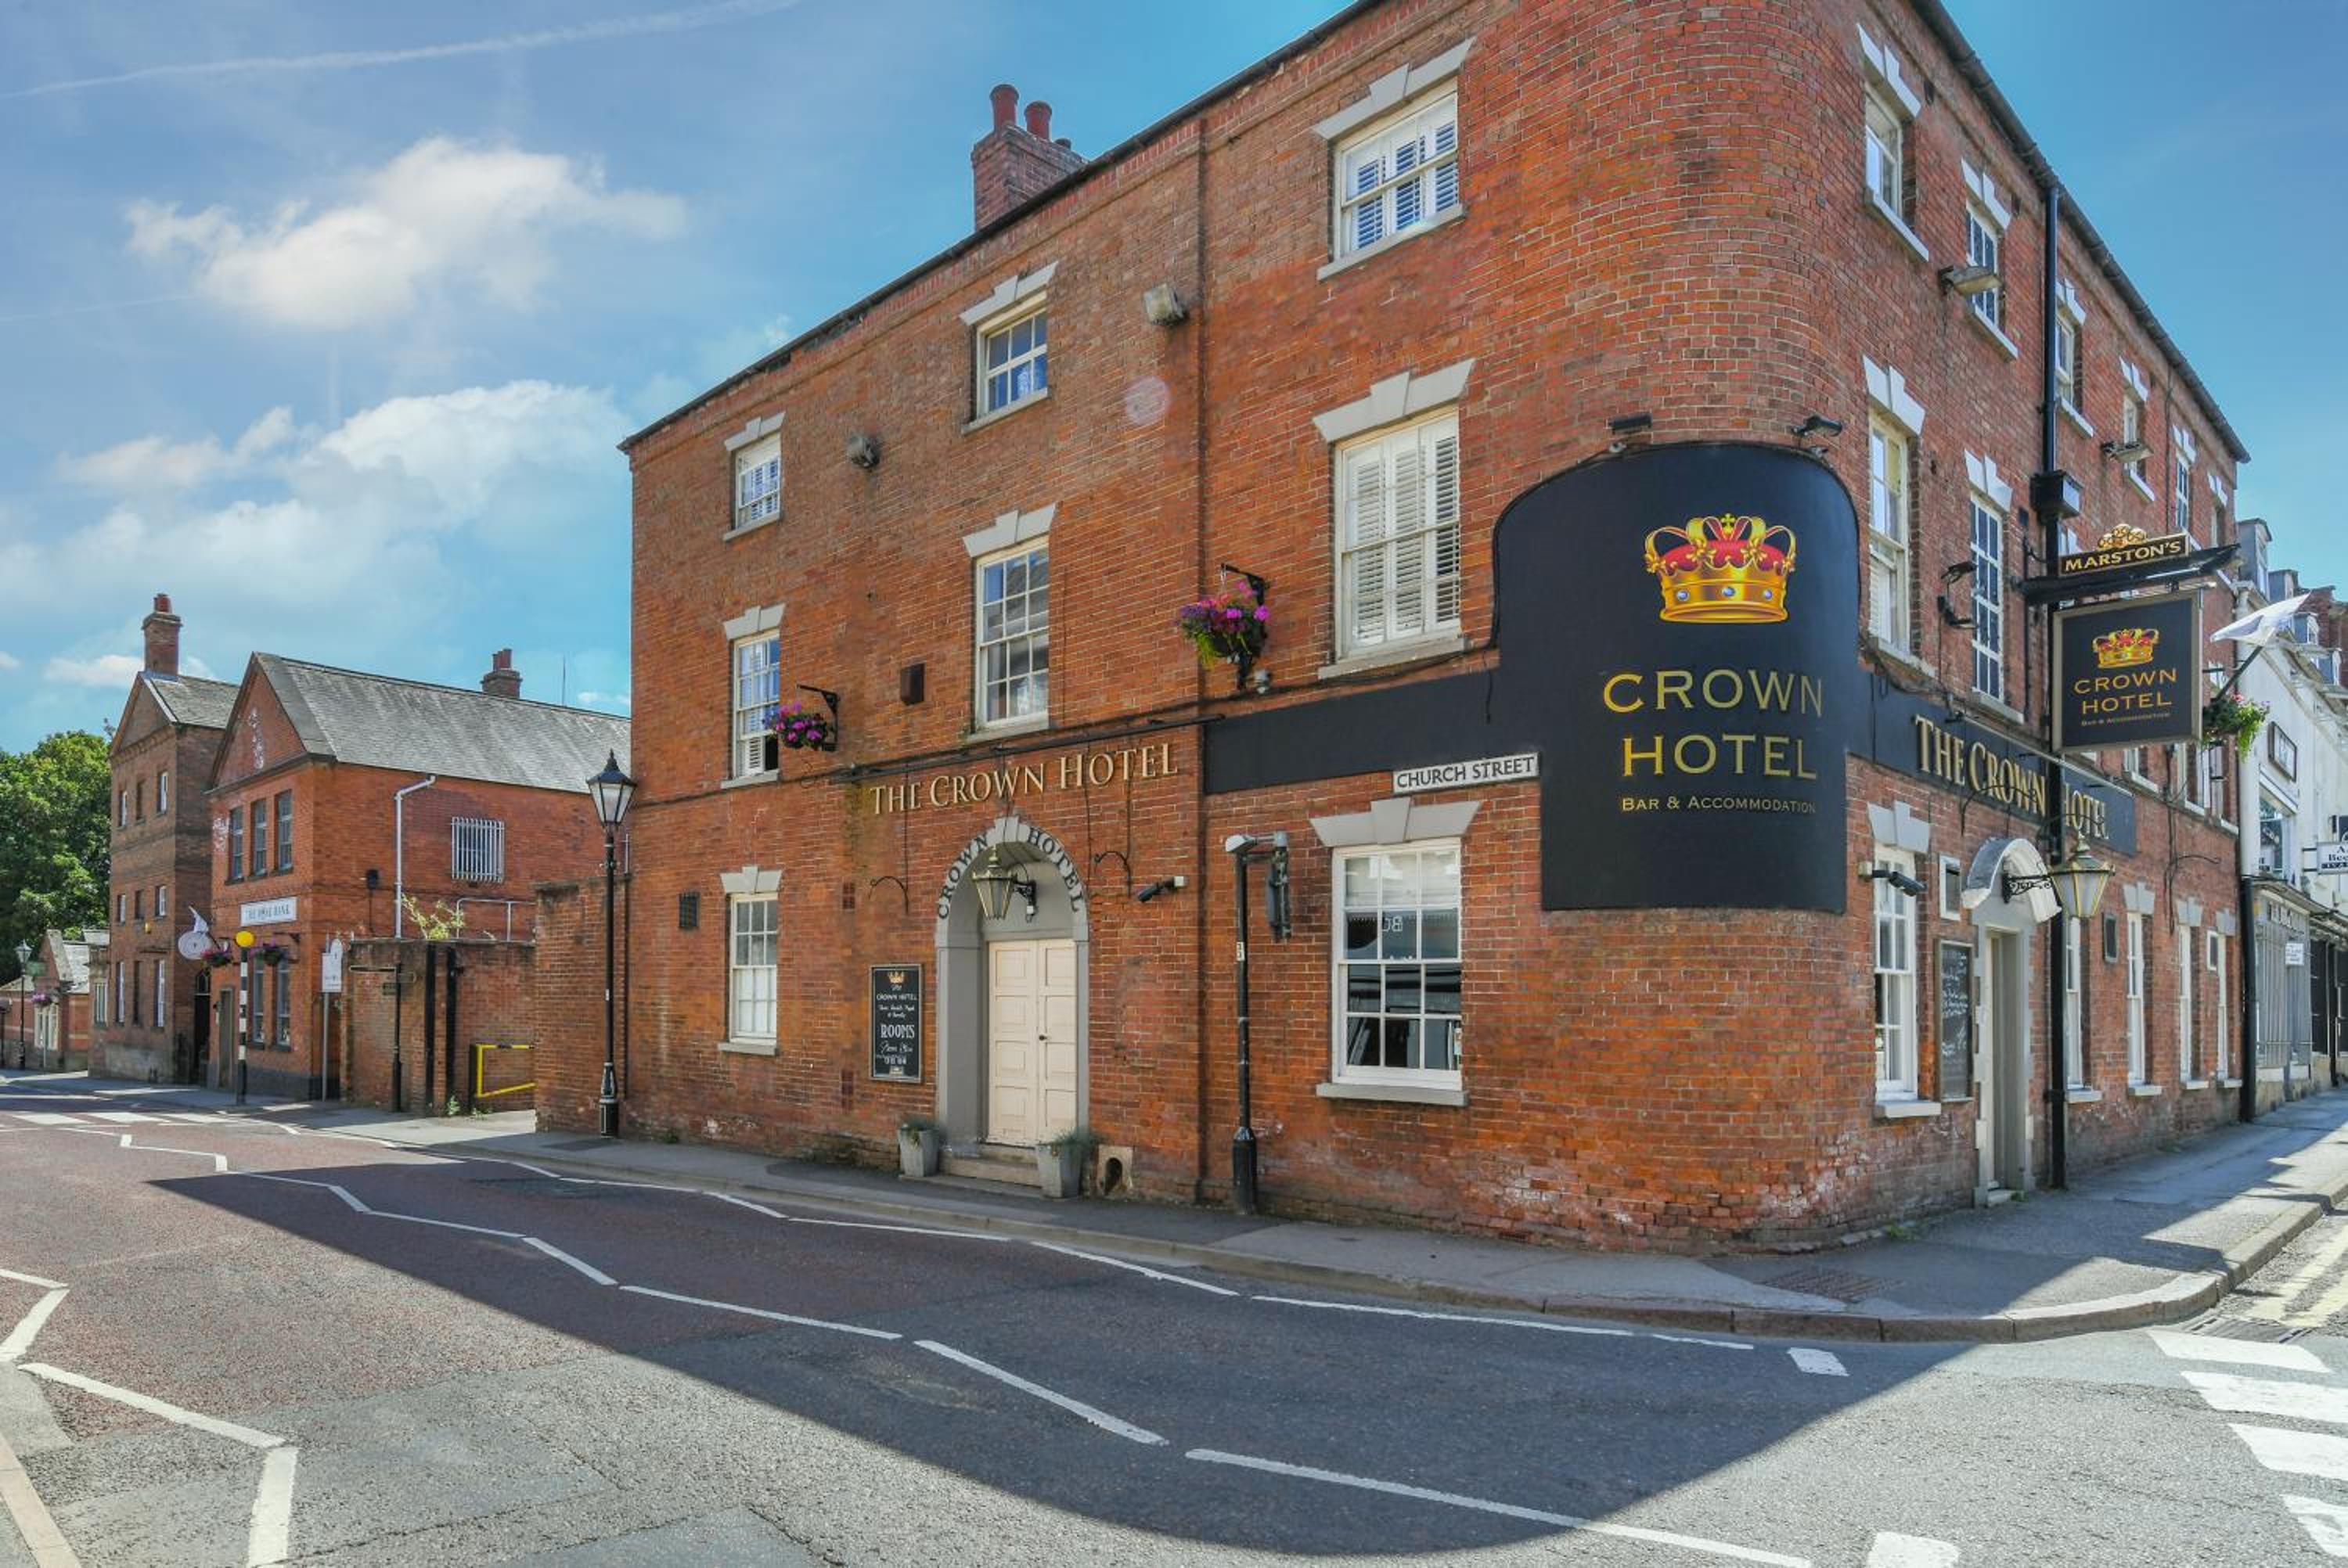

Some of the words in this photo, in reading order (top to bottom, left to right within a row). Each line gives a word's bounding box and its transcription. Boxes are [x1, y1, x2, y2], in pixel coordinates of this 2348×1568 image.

[2065, 540, 2181, 572] MARSTON'S
[1604, 668, 1823, 718] CROWN
[2074, 667, 2178, 695] CROWN
[2081, 691, 2173, 714] HOTEL
[1396, 765, 1467, 789] CHURCH
[1471, 756, 1535, 779] STREET
[1622, 732, 1817, 781] HOTEL
[1915, 714, 1966, 786] THE
[1968, 741, 2047, 818] CROWN
[869, 781, 923, 815] THE
[929, 763, 1045, 808] CROWN
[1060, 742, 1179, 789] HOTEL
[1622, 797, 1660, 812] BAR
[1666, 795, 1680, 810] &
[1687, 795, 1817, 815] ACCOMMODATION
[938, 831, 989, 920] CROWN
[1027, 826, 1084, 913] HOTEL
[880, 1024, 915, 1039] ROOMS
